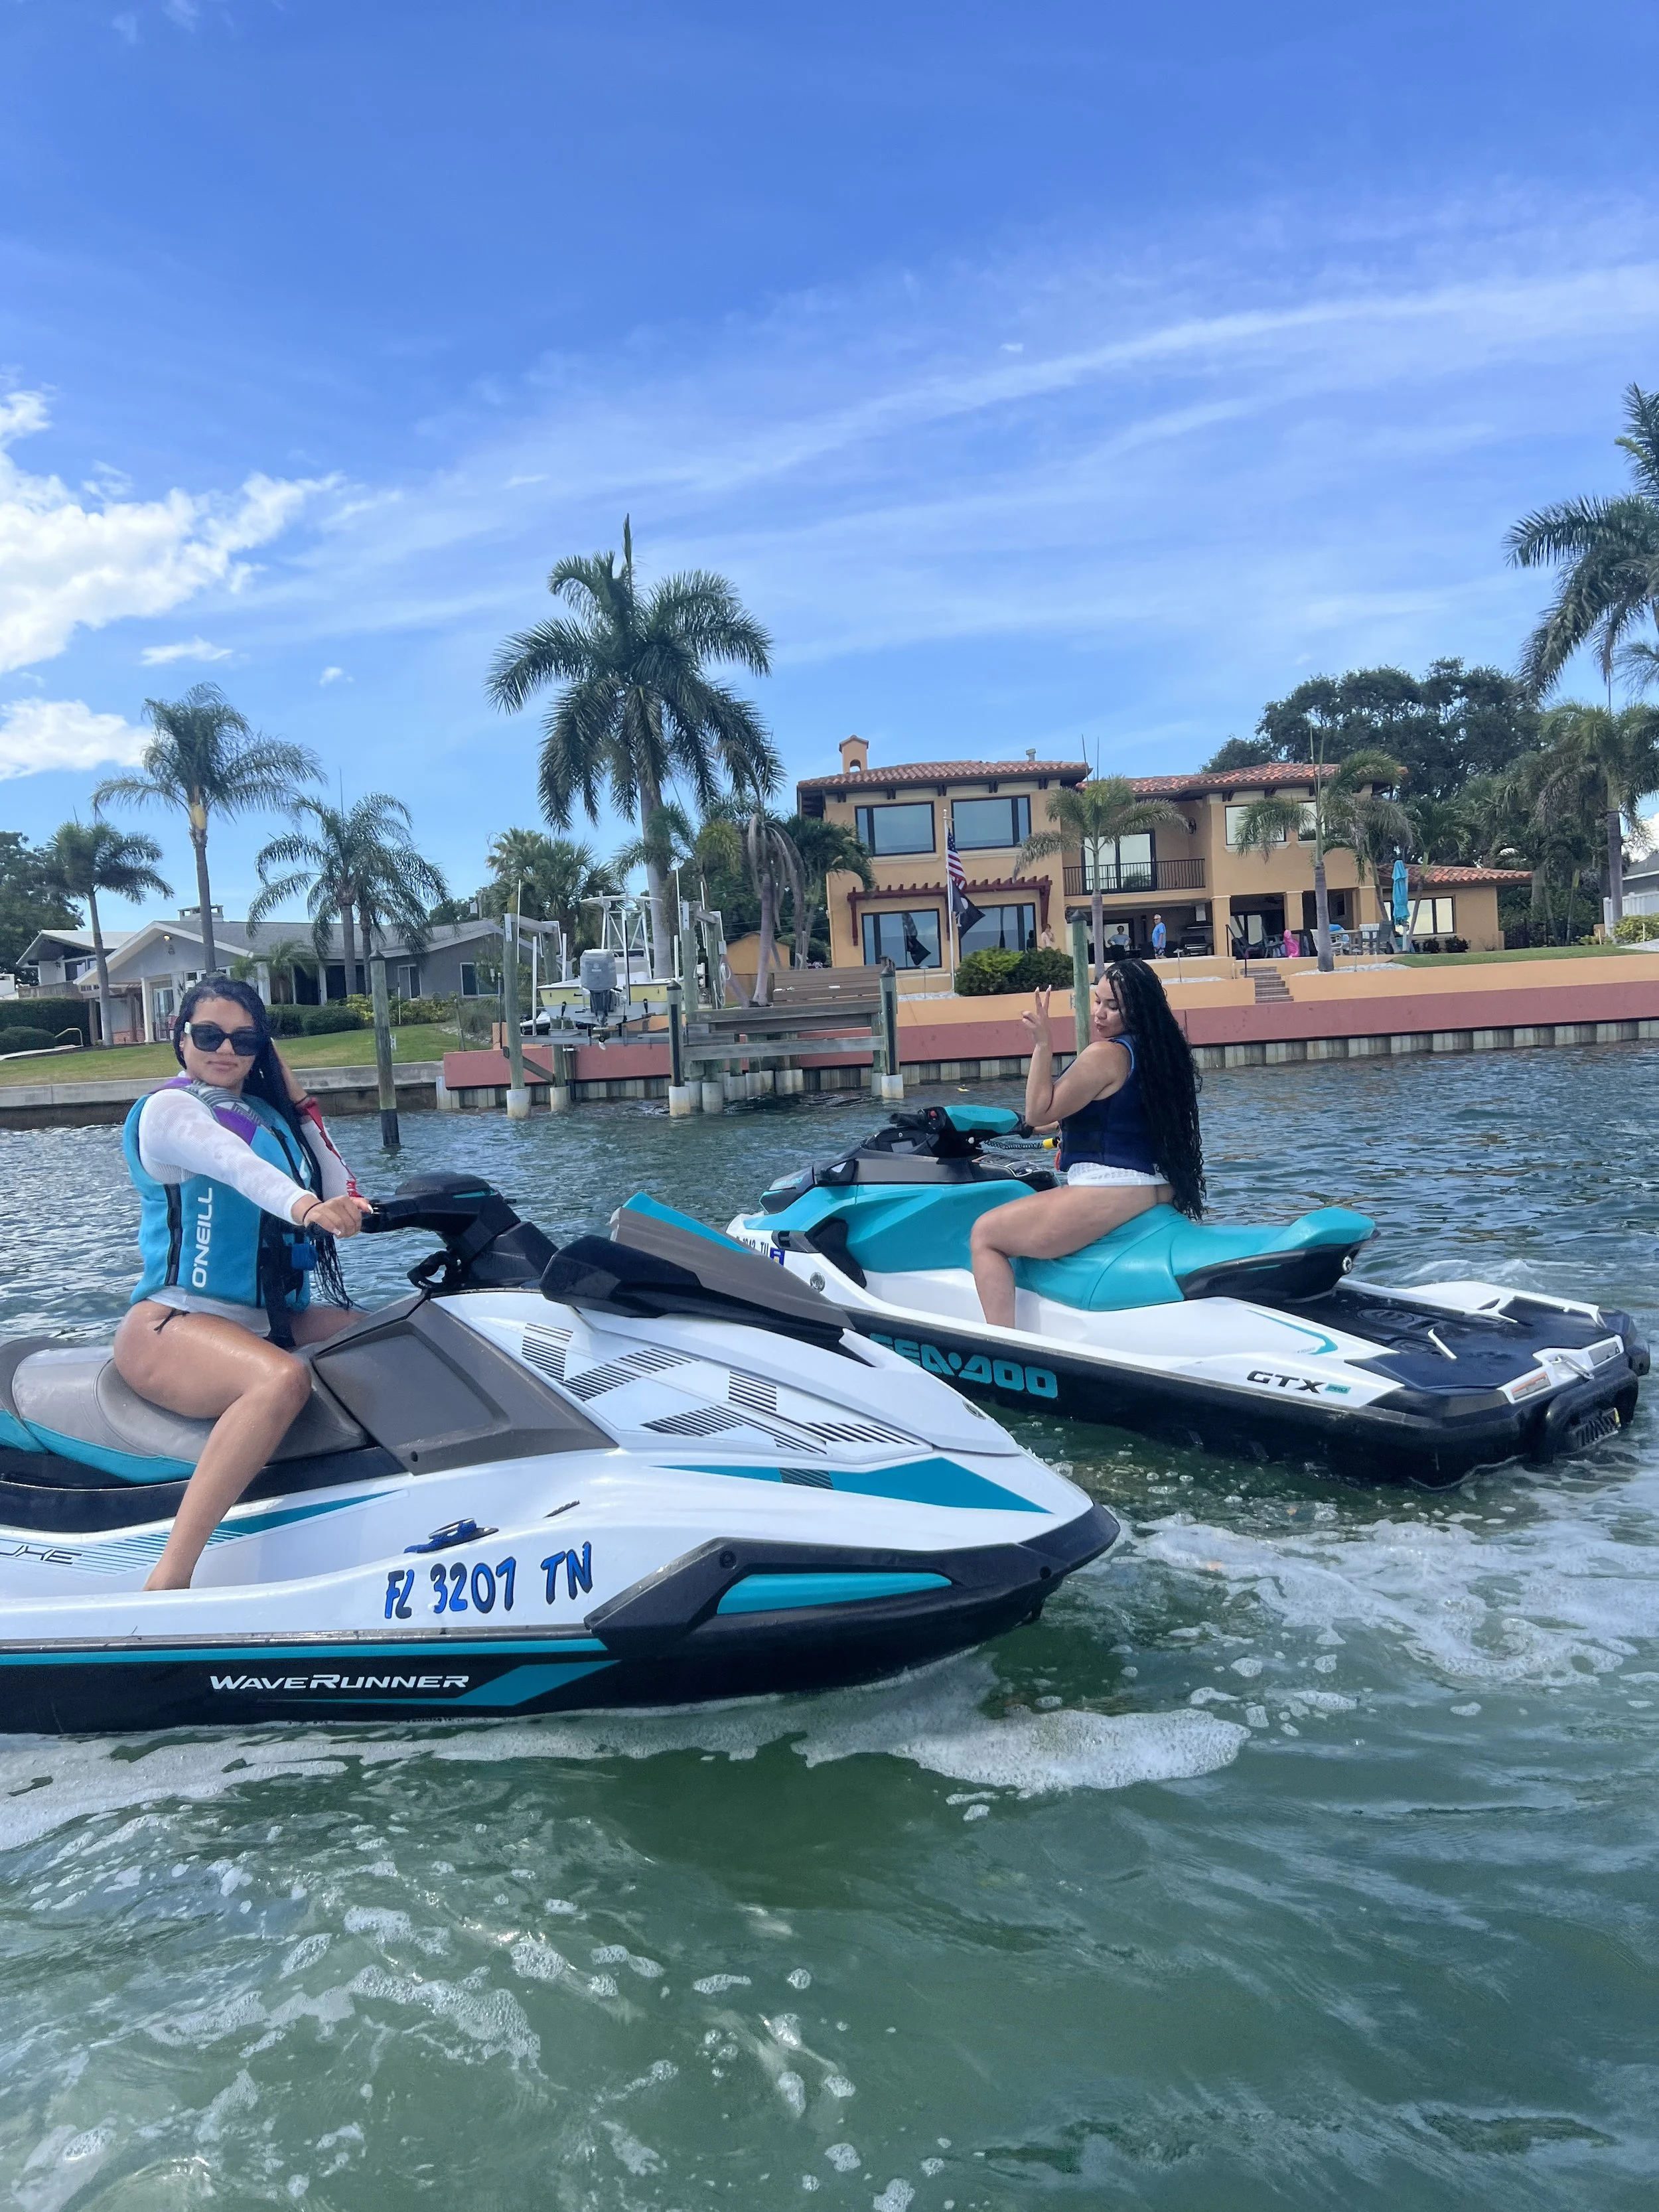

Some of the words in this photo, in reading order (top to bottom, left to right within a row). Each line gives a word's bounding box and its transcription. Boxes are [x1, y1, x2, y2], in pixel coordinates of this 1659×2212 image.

[192, 1187, 212, 1288] O'NEILL
[1246, 1370, 1326, 1394] GTX
[541, 1540, 593, 1605] TN
